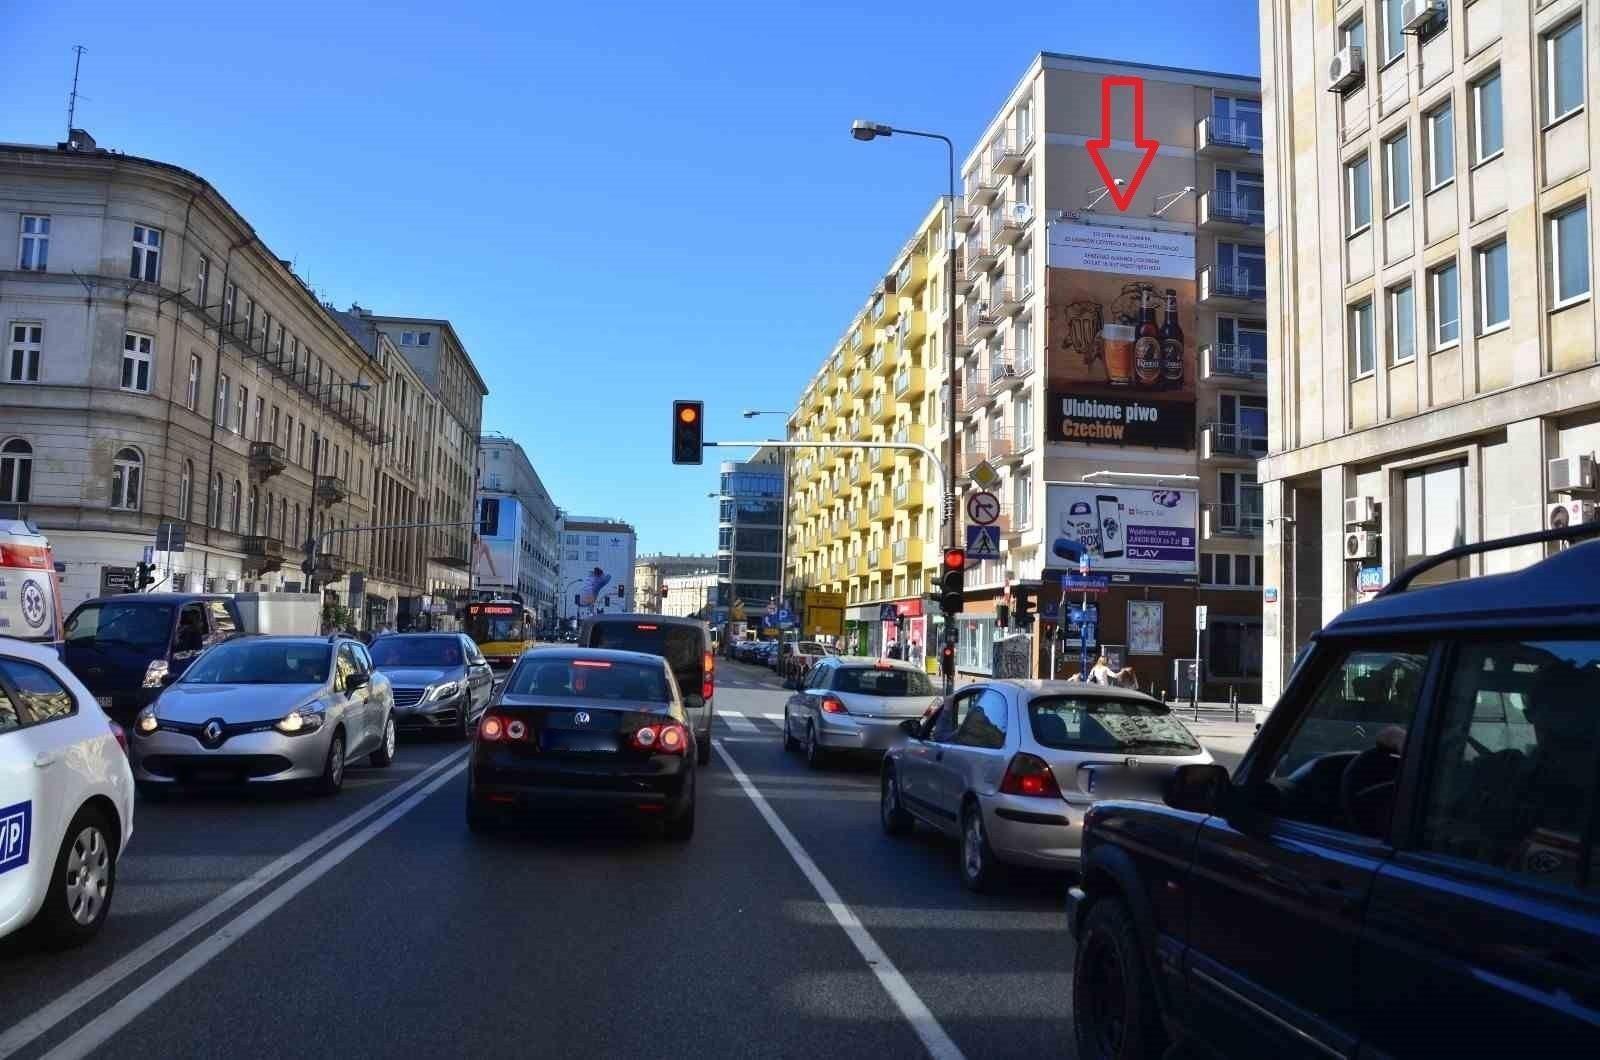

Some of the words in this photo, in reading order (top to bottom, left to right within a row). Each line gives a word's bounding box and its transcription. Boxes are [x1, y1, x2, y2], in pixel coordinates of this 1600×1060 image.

[1062, 398, 1122, 420] Ulubione
[1125, 402, 1159, 423] piwo
[1062, 419, 1125, 439] Czechów
[1128, 548, 1159, 558] PLAY
